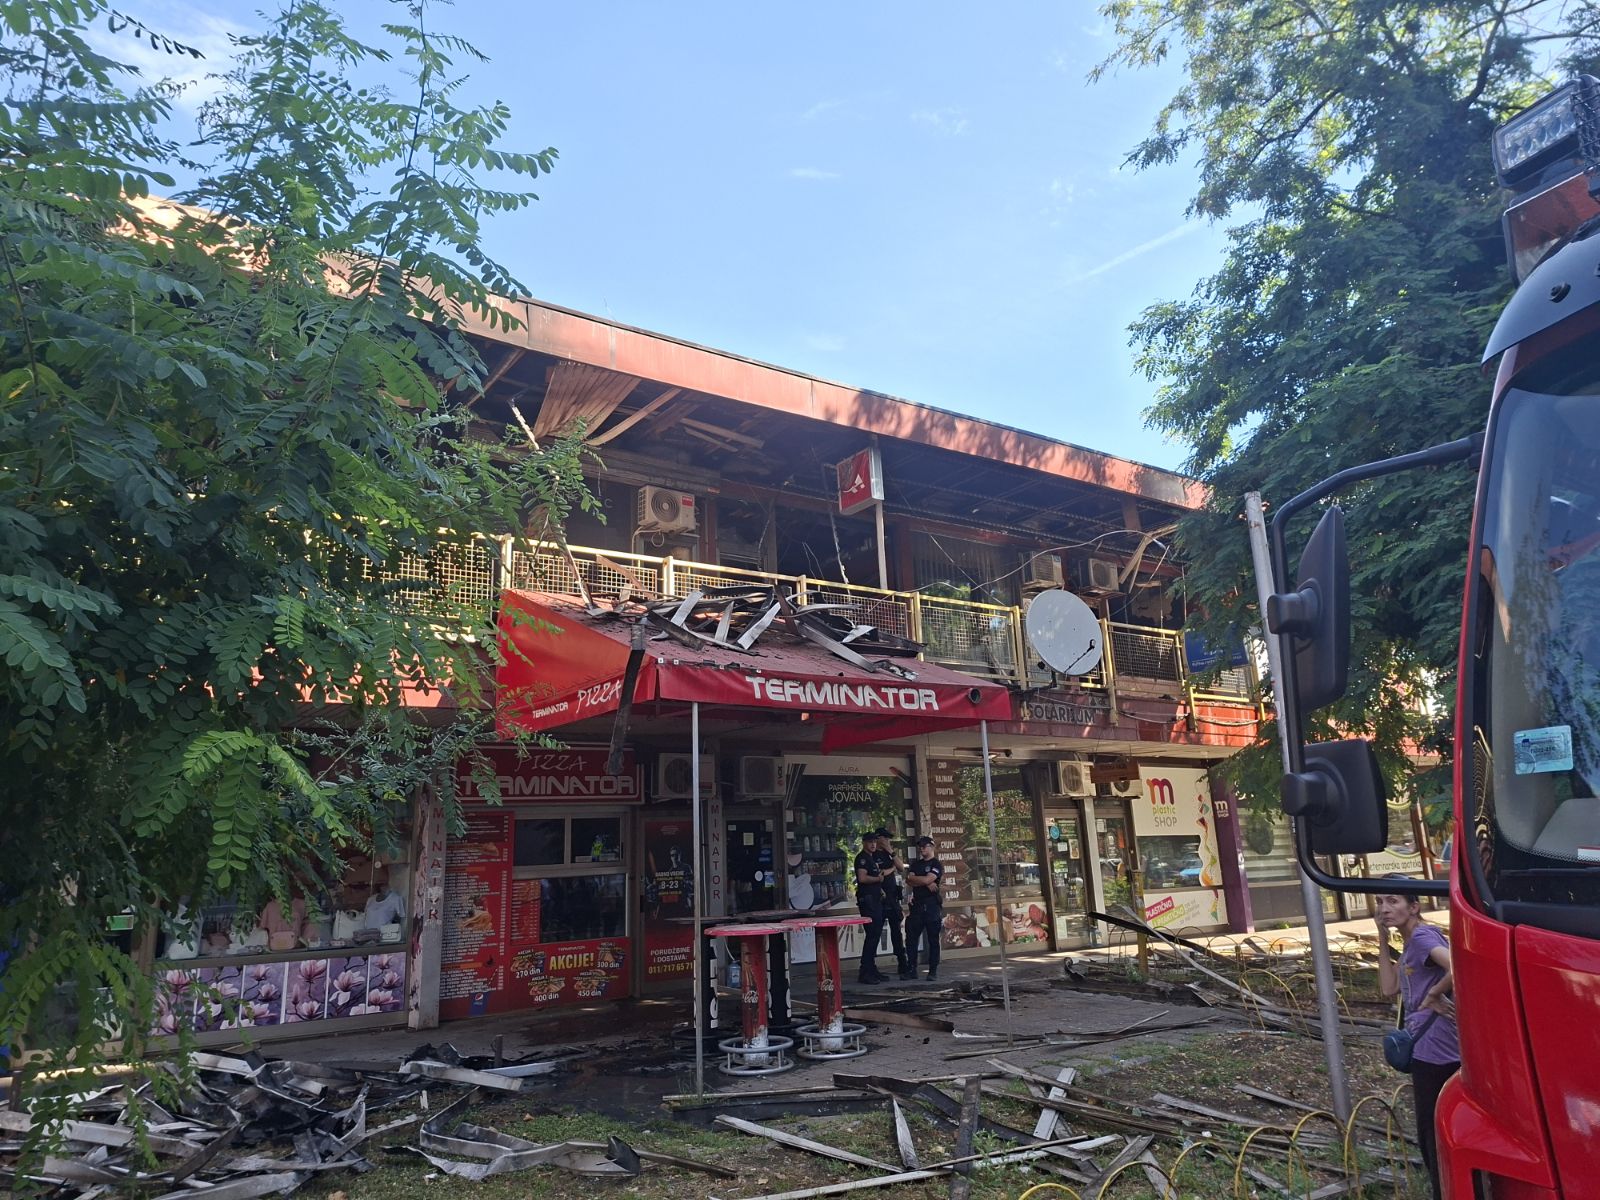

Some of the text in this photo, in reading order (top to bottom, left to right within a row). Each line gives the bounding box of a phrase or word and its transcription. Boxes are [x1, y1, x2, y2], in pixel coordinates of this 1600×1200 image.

[532, 680, 622, 719] TERMINATOR PIZZA
[745, 675, 939, 711] TERMINATOR
[514, 754, 587, 772] PIZZA
[459, 775, 635, 795] TRMINATOR
[829, 791, 872, 803] JOVANA
[1152, 806, 1176, 816] plastic
[1154, 816, 1178, 827] SHOP
[549, 952, 595, 971] AKCIJE!
[609, 960, 620, 968] din
[515, 965, 541, 979] 270 din
[534, 992, 559, 1002] 400 din
